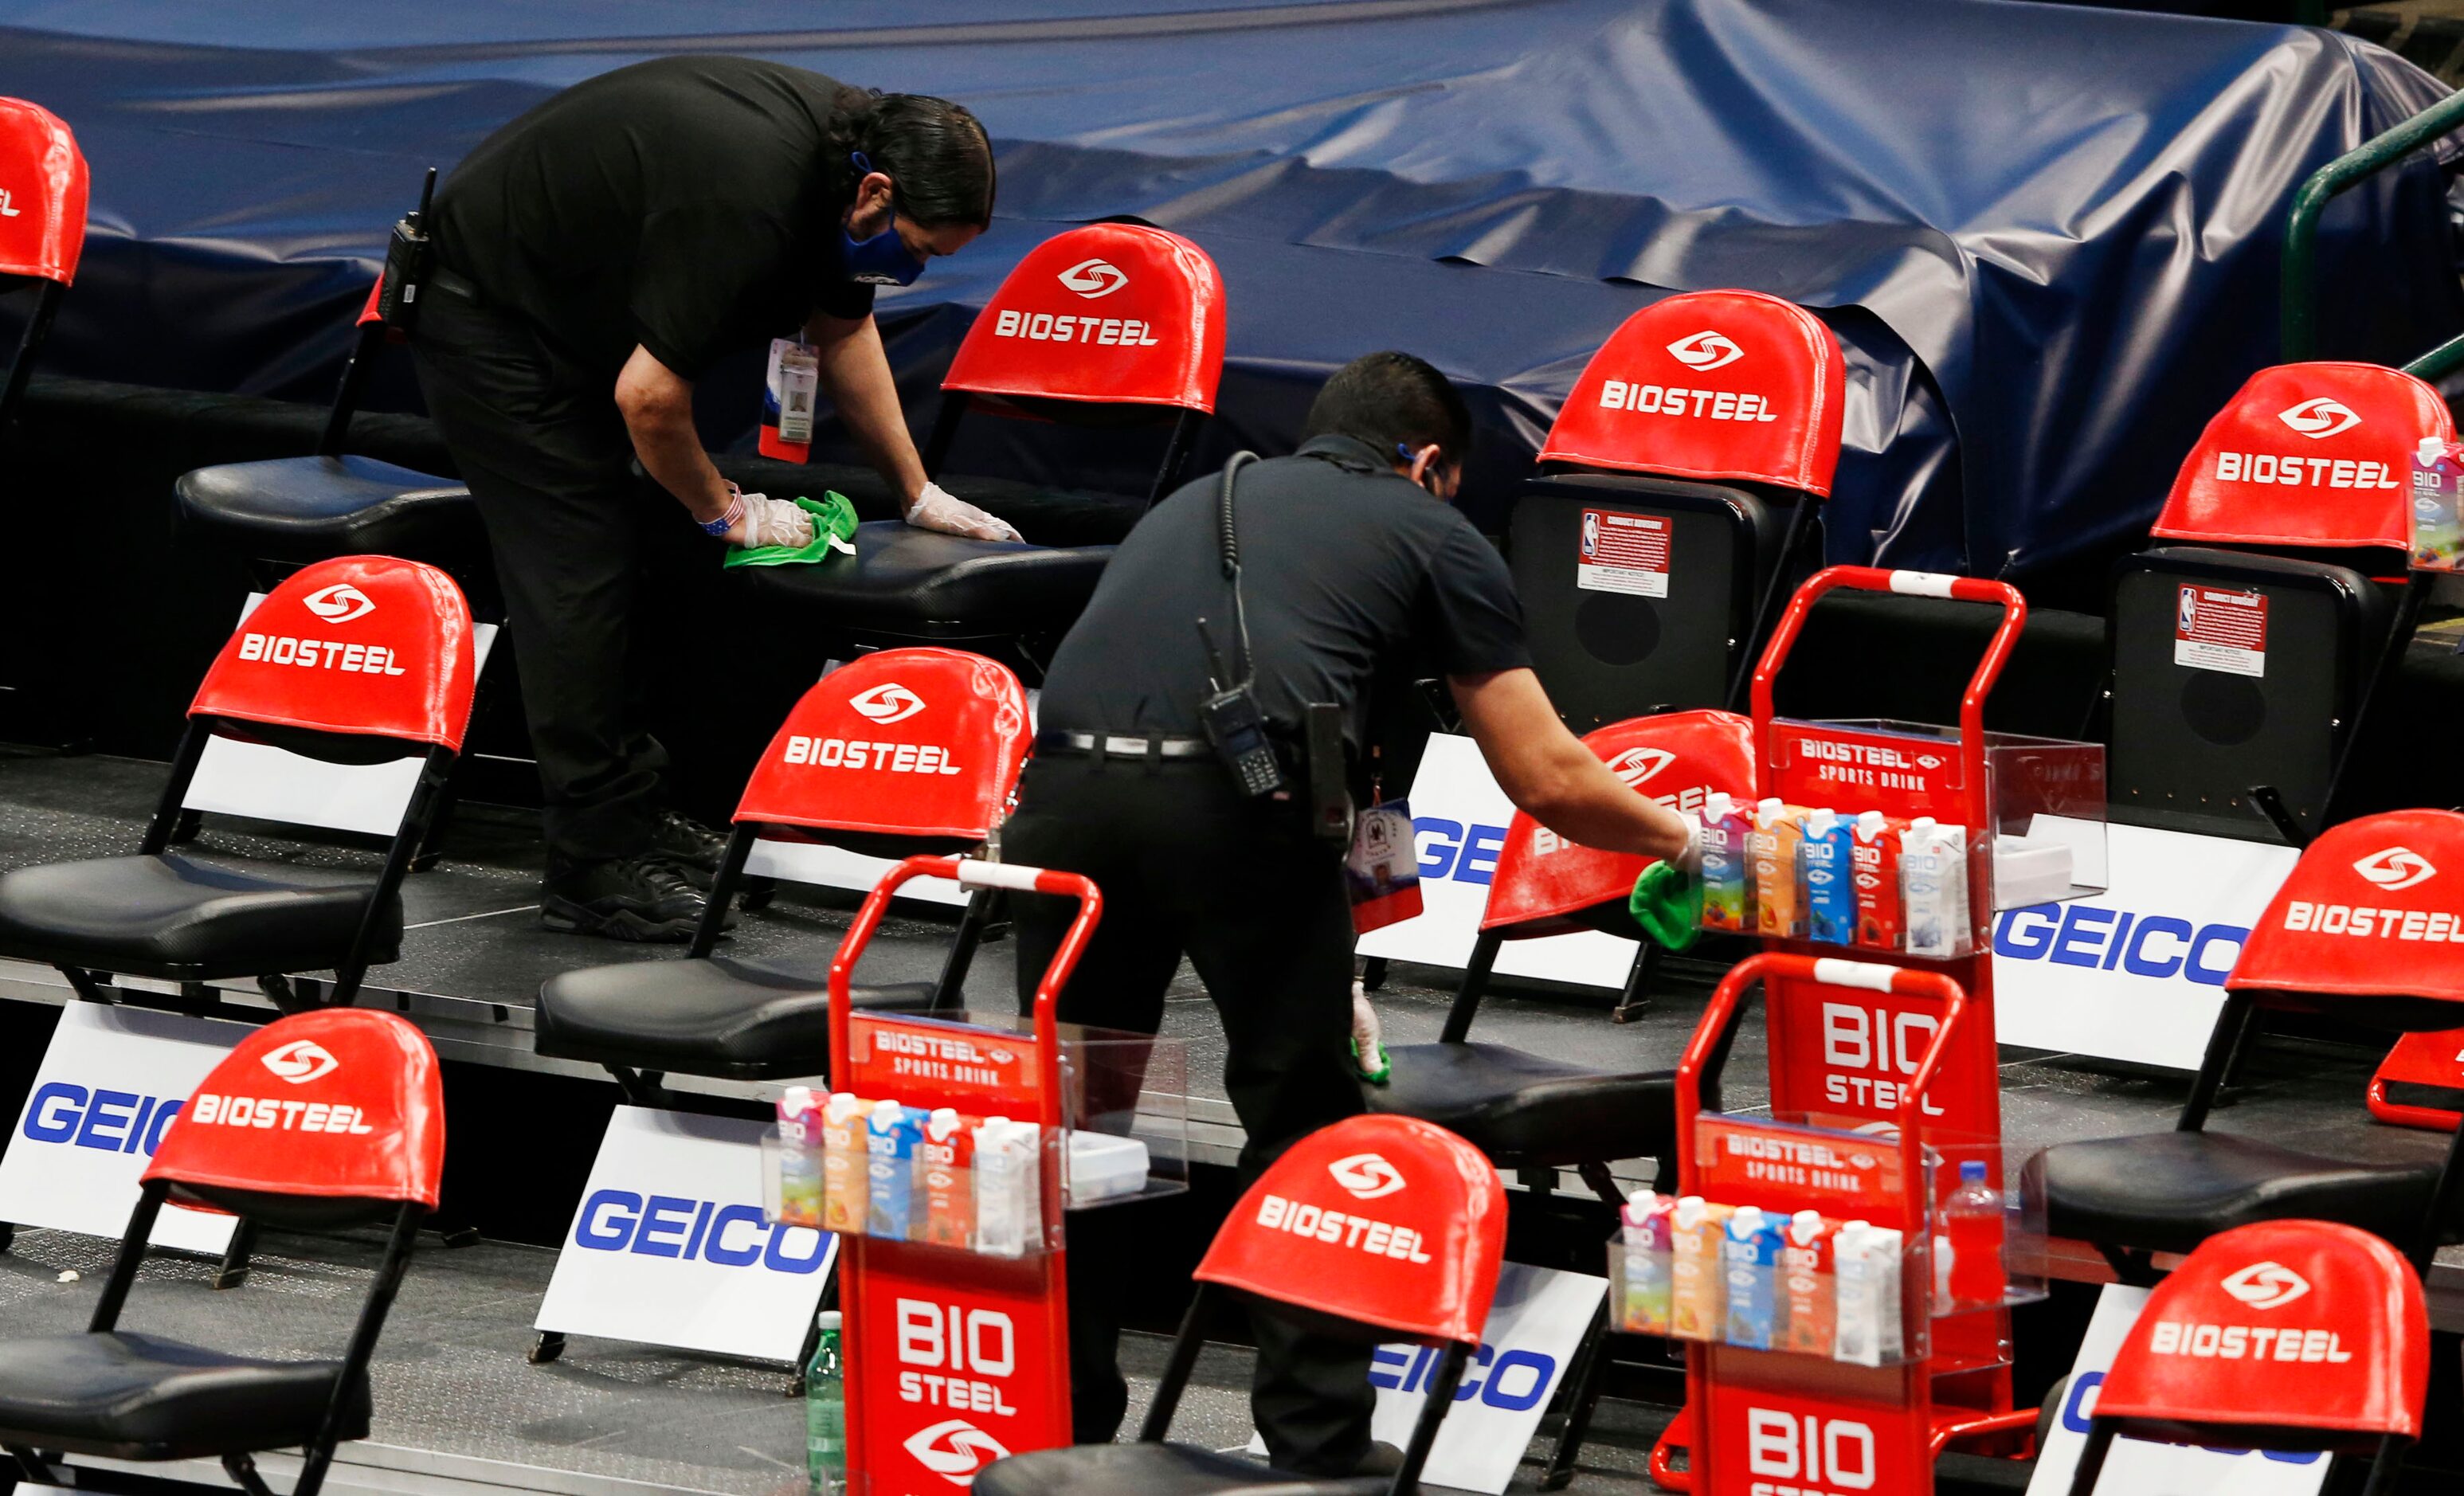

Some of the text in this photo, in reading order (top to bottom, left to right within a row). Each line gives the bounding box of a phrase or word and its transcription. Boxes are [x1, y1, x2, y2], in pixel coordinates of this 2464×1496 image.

[994, 310, 1159, 346] BIOSTEEL
[1599, 380, 1778, 424] BIOSTEEL
[2215, 451, 2401, 490] BIOSTEEL
[238, 632, 406, 676] BIOSTEEL
[783, 735, 962, 776] BIOSTEEL
[1800, 738, 1913, 770] BIOSTEEL
[1820, 763, 1926, 792] SPORTS DRINK
[2283, 899, 2464, 944] BIOSTEEL
[1993, 902, 2251, 987] GEICO
[875, 1029, 985, 1064] BIOSTEEL
[894, 1057, 1000, 1087] SPORTS DRINK
[191, 1094, 374, 1135] BIOSTEEL
[1726, 1133, 1845, 1169] BIOSTEEL
[1746, 1161, 1862, 1193] SPORTS DRINK
[574, 1189, 833, 1275] GEICO
[1256, 1193, 1432, 1265] BIOSTEEL
[897, 1298, 1015, 1378] BIO
[2149, 1320, 2352, 1364] BIOSTEEL
[899, 1370, 1017, 1417] STEEL
[1747, 1407, 1876, 1490] BIO
